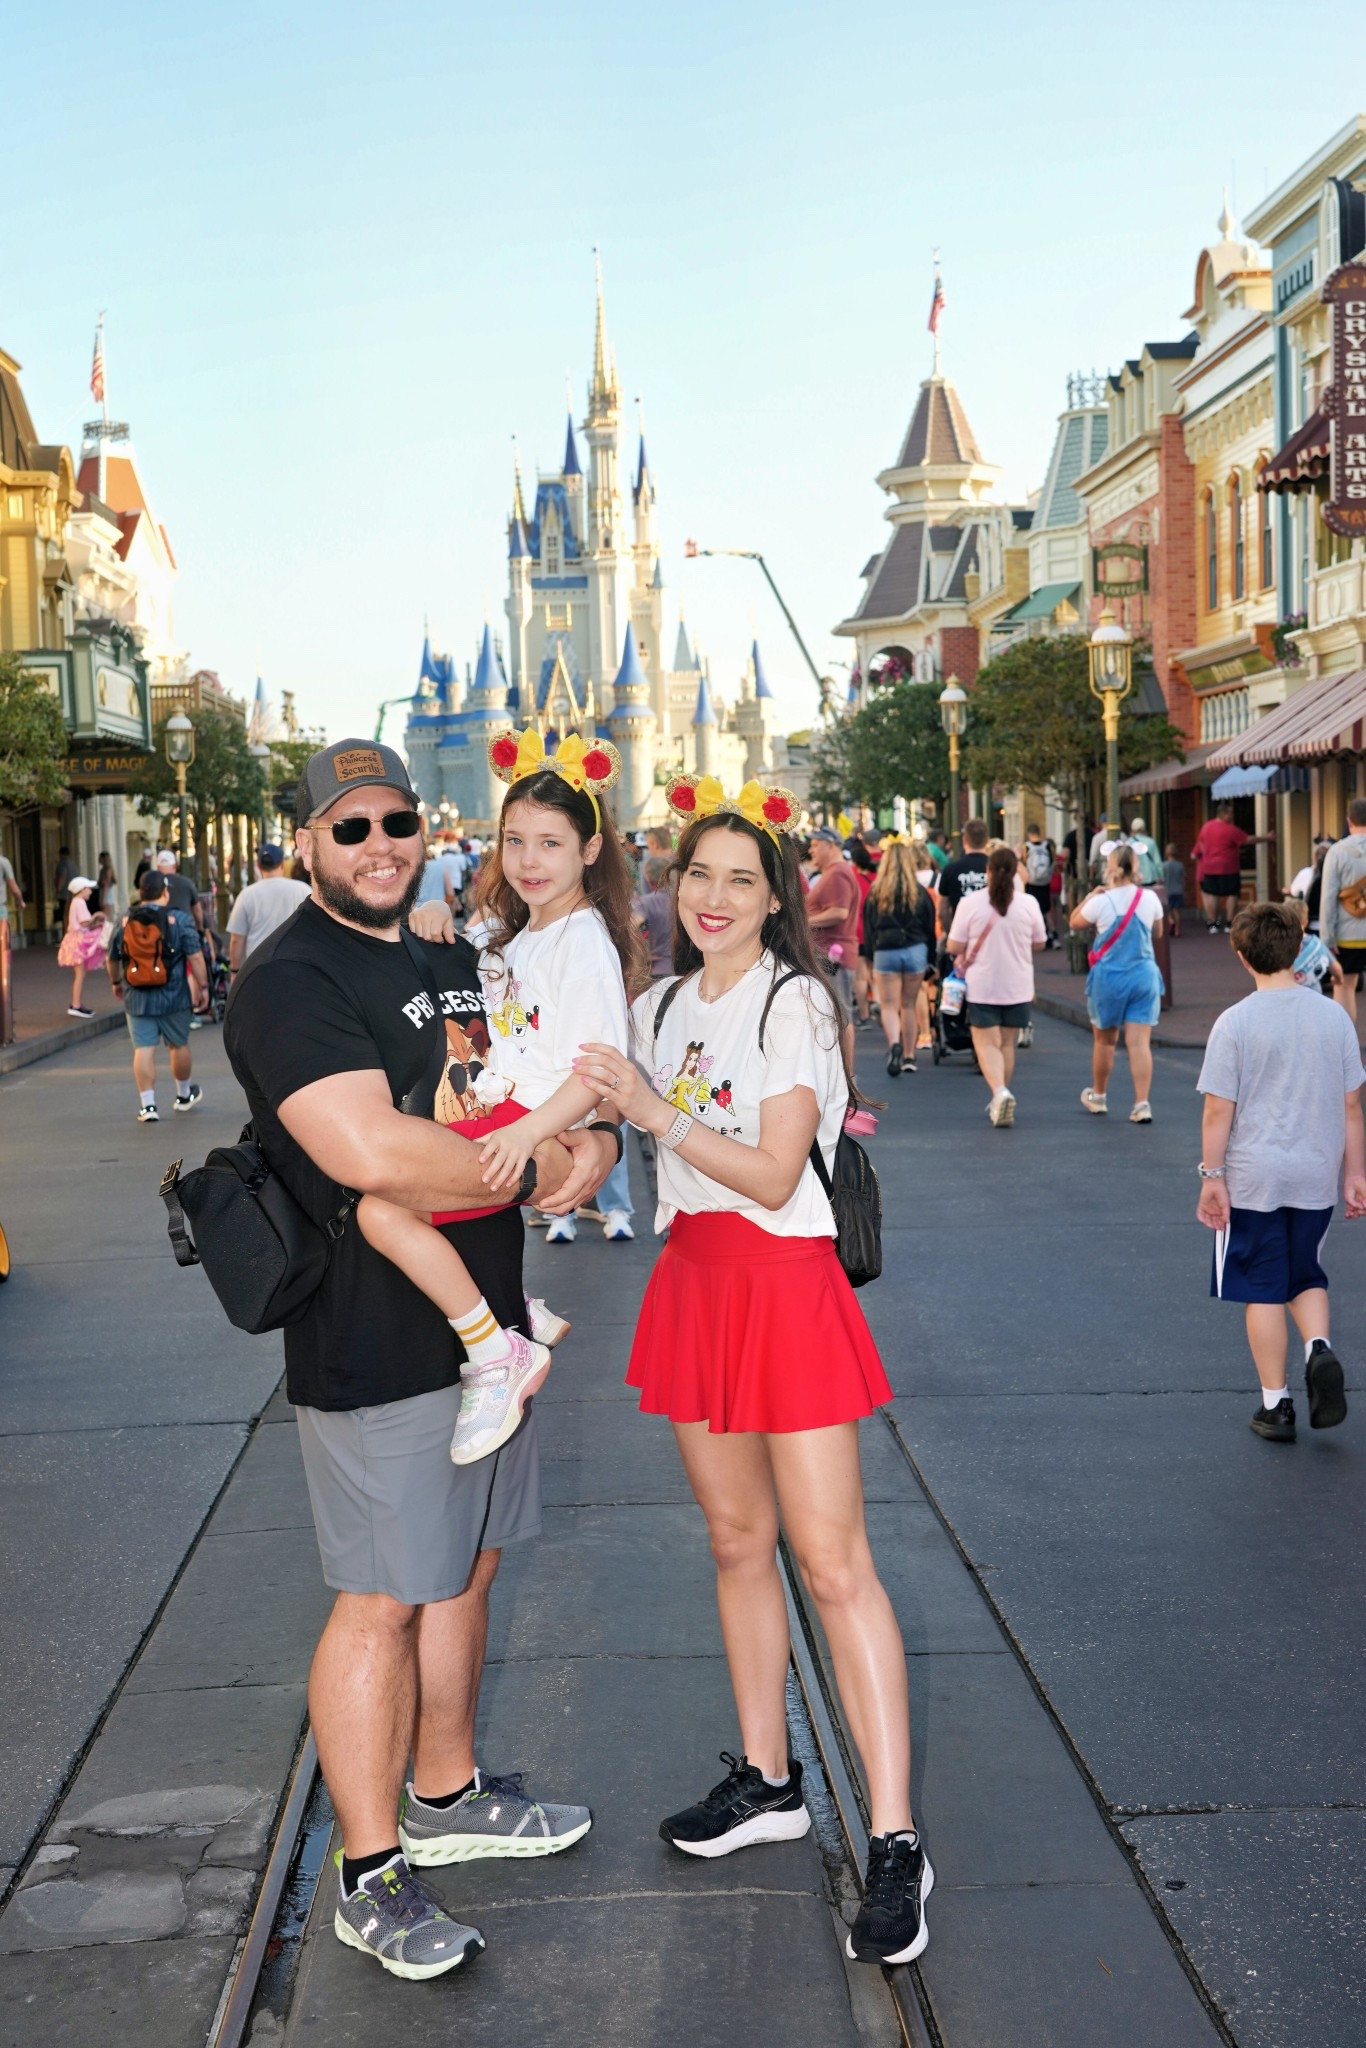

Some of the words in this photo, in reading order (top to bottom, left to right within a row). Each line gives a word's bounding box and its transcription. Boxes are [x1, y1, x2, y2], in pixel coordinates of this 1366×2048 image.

[1344, 301, 1366, 416] CRYSTAL
[1345, 434, 1366, 498] ARTS
[83, 757, 102, 772] OF
[341, 763, 382, 778] Security
[401, 989, 487, 1030] PRICESS
